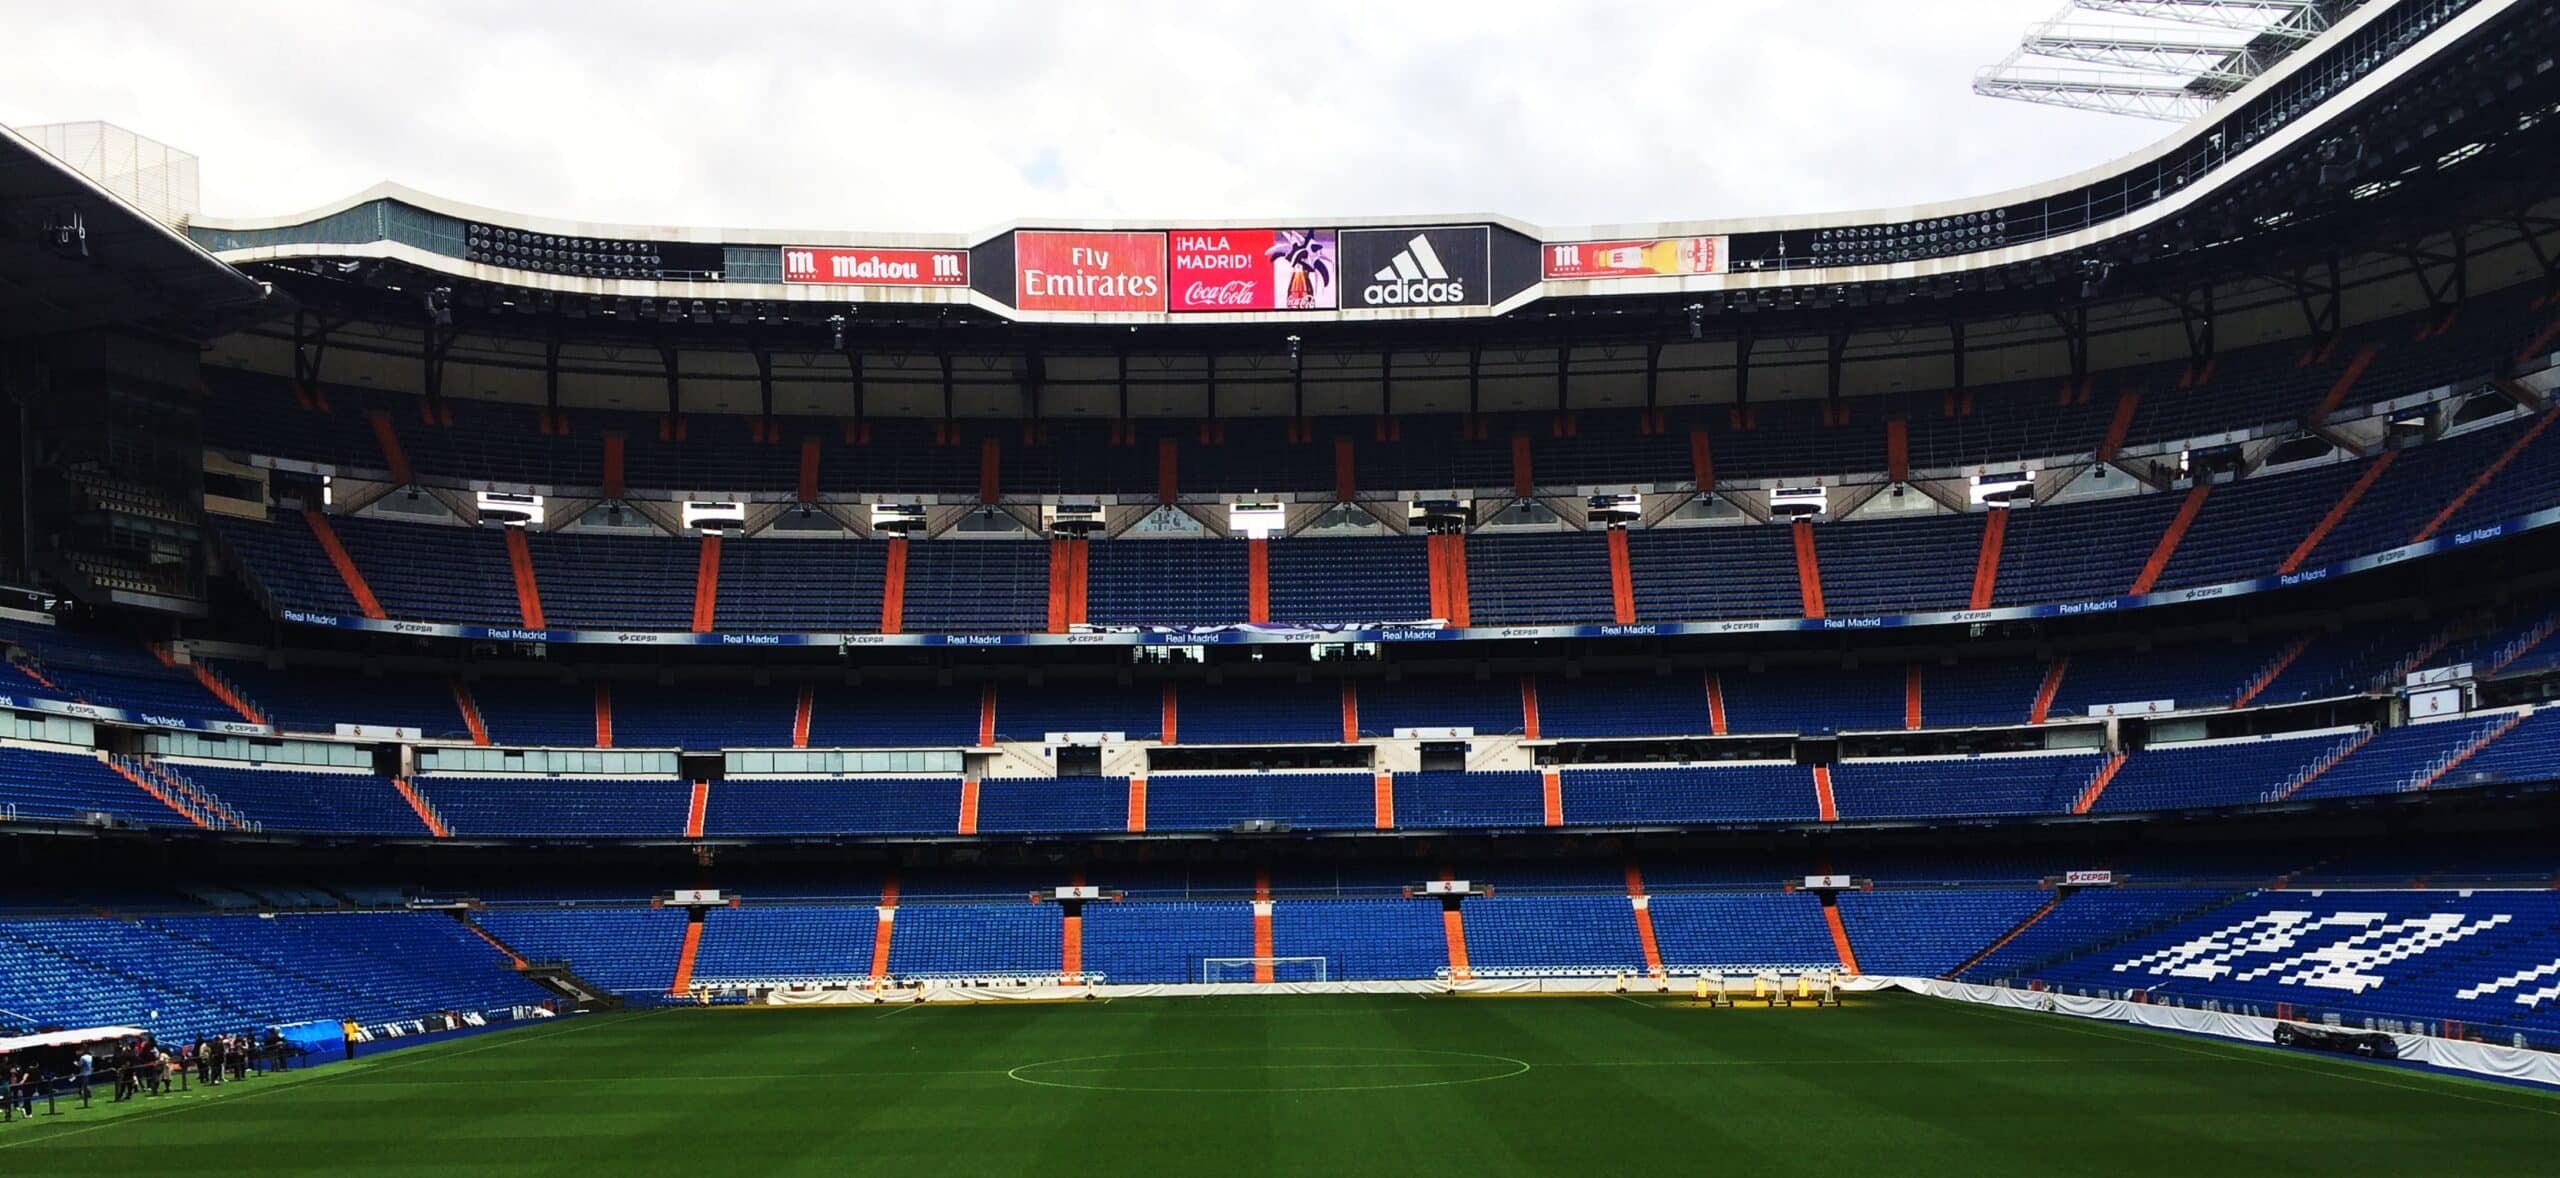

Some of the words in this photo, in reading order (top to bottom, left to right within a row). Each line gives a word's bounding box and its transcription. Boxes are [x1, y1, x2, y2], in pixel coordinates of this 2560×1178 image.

[1176, 237, 1231, 251] ¡HALA
[1071, 247, 1110, 270] Fly
[1177, 254, 1252, 269] MADRID!
[830, 256, 919, 279] Mahou
[1023, 269, 1158, 297] Emirates
[1364, 278, 1464, 304] adidas
[2455, 533, 2472, 545] Real
[2473, 526, 2501, 540] Madrid
[2281, 574, 2299, 585] Real
[2301, 568, 2327, 581] Madrid
[2197, 588, 2223, 598] CEPSA
[2060, 602, 2081, 614] Real
[2084, 600, 2118, 612] Madrid
[284, 610, 304, 622] Real
[306, 612, 337, 626] Madrid
[1824, 618, 1846, 629] Real
[1848, 617, 1881, 628] Madrid
[405, 624, 433, 633] CEPSA
[1601, 625, 1622, 635] Real
[1624, 625, 1656, 635] Madrid
[1733, 622, 1760, 630] CEPSA
[488, 629, 511, 639] Real
[512, 630, 547, 641] Madrid
[630, 634, 657, 642] CEPSA
[723, 635, 744, 644] Real
[746, 634, 779, 644] Madrid
[947, 635, 968, 645] Real
[969, 635, 1001, 645] Madrid
[1078, 635, 1104, 643] CEPSA
[1165, 633, 1186, 643] Real
[1187, 632, 1219, 643] Madrid
[1295, 633, 1320, 641] CEPSA
[1382, 631, 1402, 641] Real
[1404, 630, 1436, 640] Madrid
[2081, 873, 2109, 881] CEPSA
